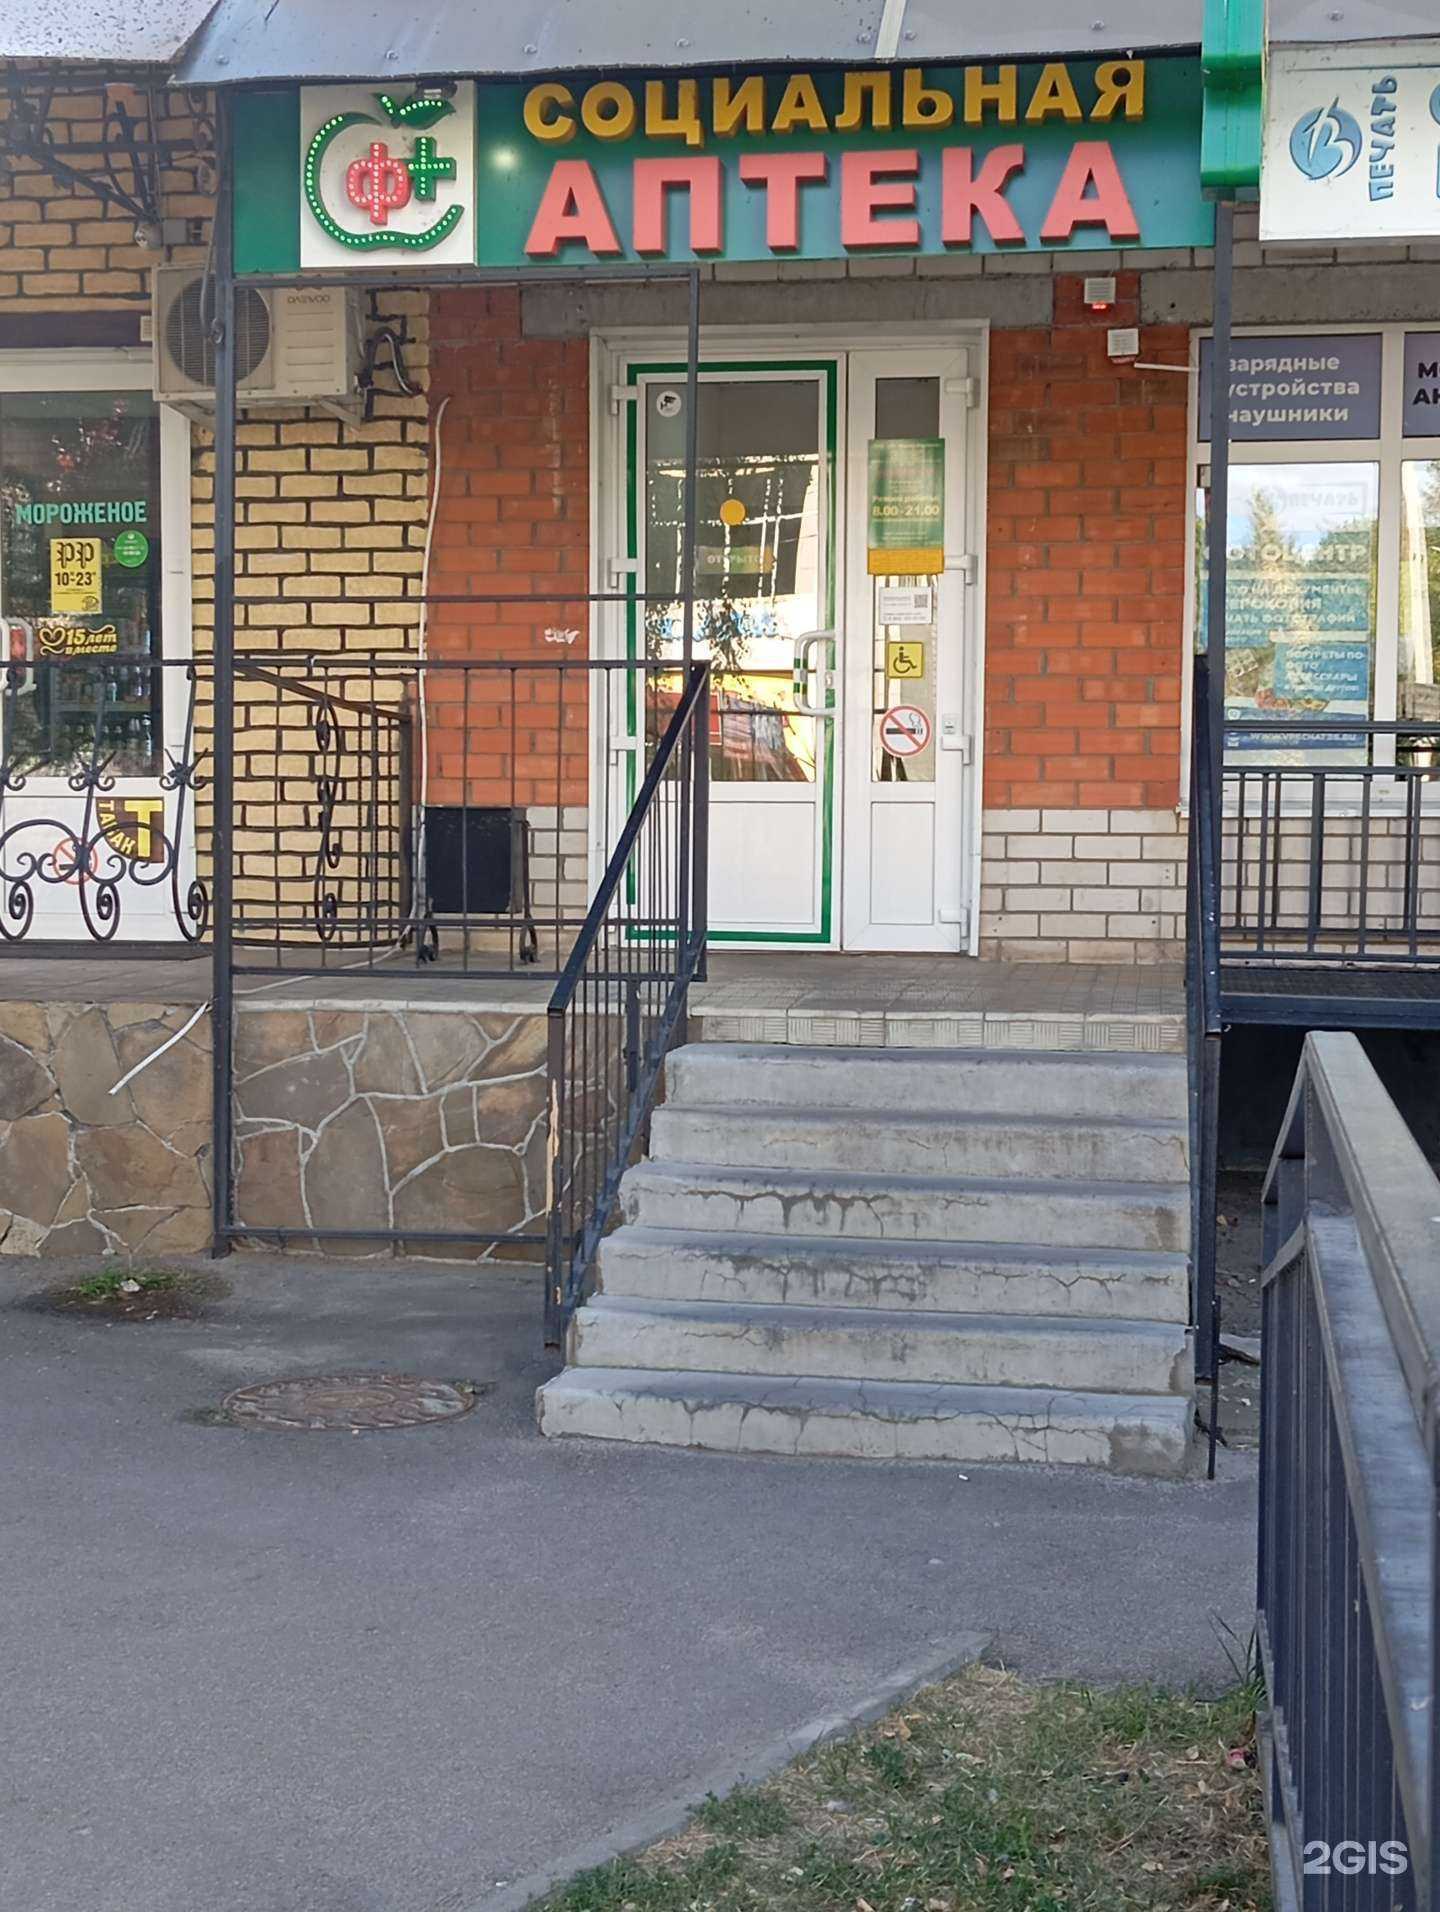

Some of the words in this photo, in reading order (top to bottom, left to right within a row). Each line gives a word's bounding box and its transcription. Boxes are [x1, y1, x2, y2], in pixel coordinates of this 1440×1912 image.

[523, 60, 1146, 146] СОЦИАЛЬНАЯ
[1369, 75, 1398, 201] ПЕЧАТЬ
[523, 140, 1142, 258] АПТЕКА
[15, 501, 147, 525] МОРОЖЕНОЕ
[66, 628, 86, 646] 15
